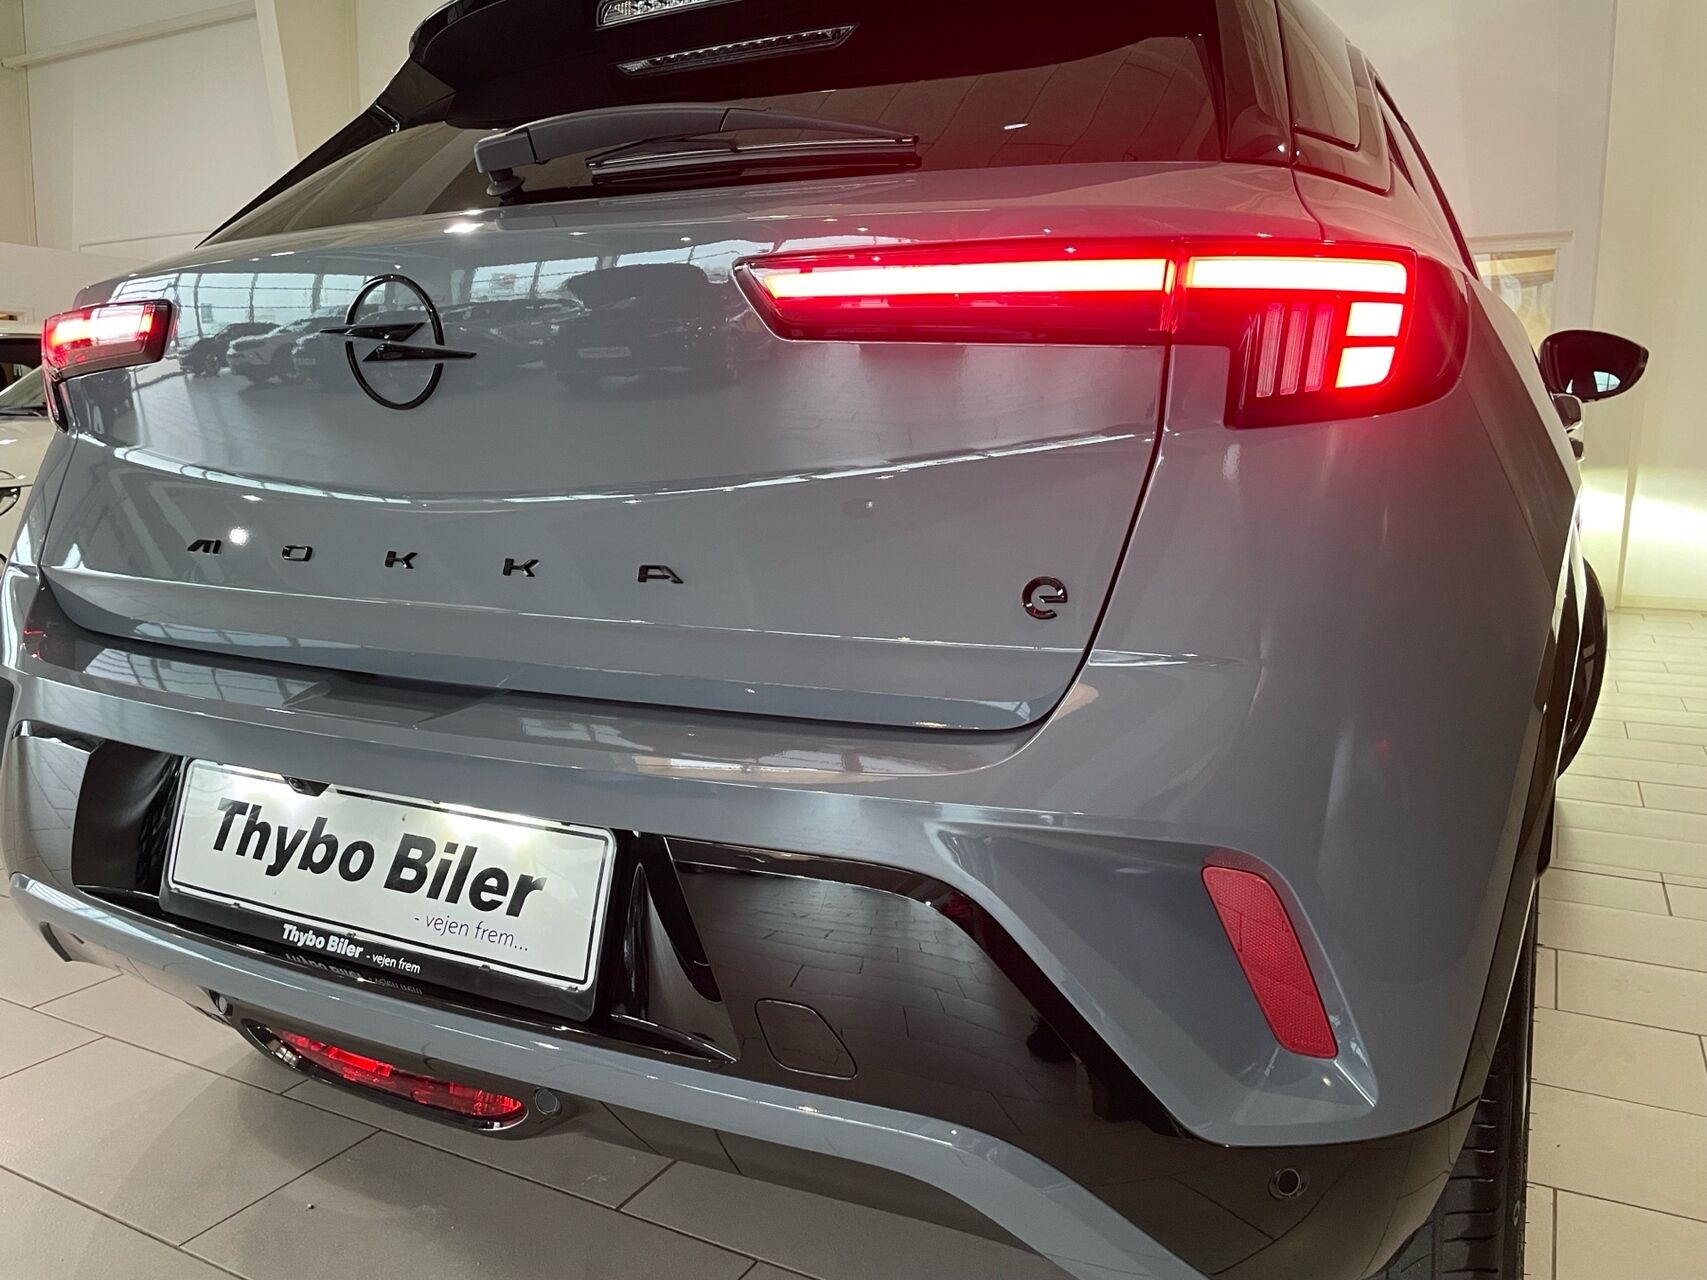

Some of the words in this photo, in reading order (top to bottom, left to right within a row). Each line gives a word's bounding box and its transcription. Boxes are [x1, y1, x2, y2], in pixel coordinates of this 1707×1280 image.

[187, 538, 684, 585] MOKKA
[212, 797, 376, 882] Thybo
[383, 832, 548, 918] Biler
[282, 922, 326, 948] Thybo
[326, 935, 364, 959] Biler
[372, 953, 397, 969] vejen
[399, 957, 421, 974] frem
[426, 914, 470, 937] vejen
[474, 920, 529, 952] frem...
